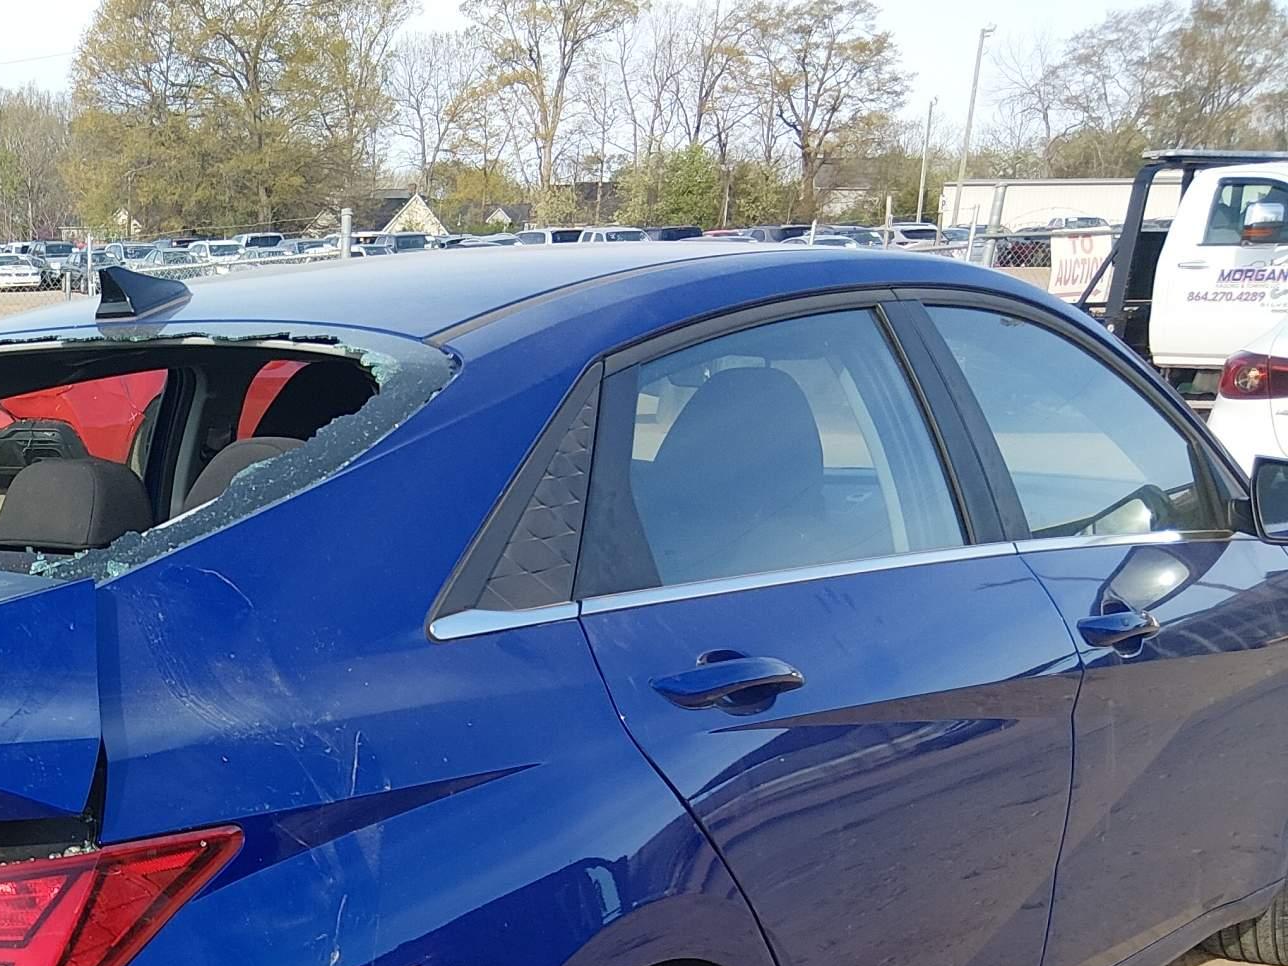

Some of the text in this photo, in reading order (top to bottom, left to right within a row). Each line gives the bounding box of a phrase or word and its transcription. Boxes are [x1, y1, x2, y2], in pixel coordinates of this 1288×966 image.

[1067, 233, 1093, 255] TO
[1216, 268, 1288, 282] MORGAN
[1186, 291, 1266, 302] 864.270.4289
